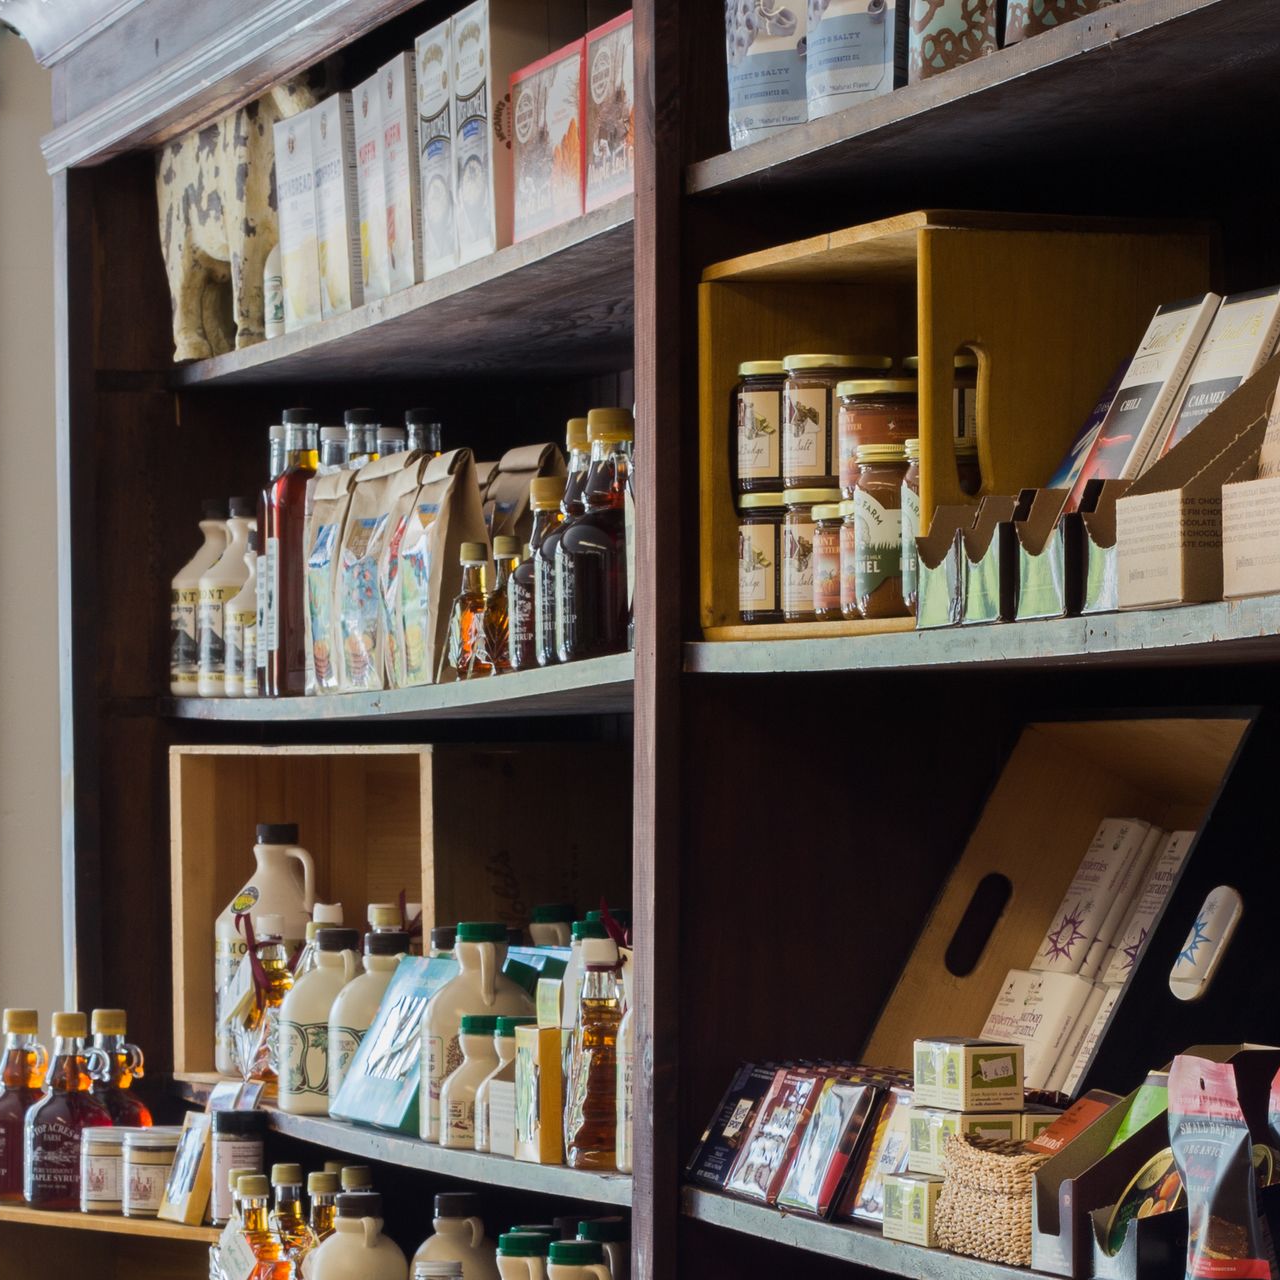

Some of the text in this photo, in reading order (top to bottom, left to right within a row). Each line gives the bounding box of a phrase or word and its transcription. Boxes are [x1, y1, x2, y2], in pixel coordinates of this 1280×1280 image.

[1120, 398, 1142, 412] CHILI
[1188, 391, 1226, 408] CARAMEL
[861, 499, 884, 526] FARM
[47, 1123, 74, 1138] ACRES
[1179, 1120, 1207, 1137] SMALL
[43, 1133, 62, 1142] FARM
[51, 1174, 81, 1183] SYRUP
